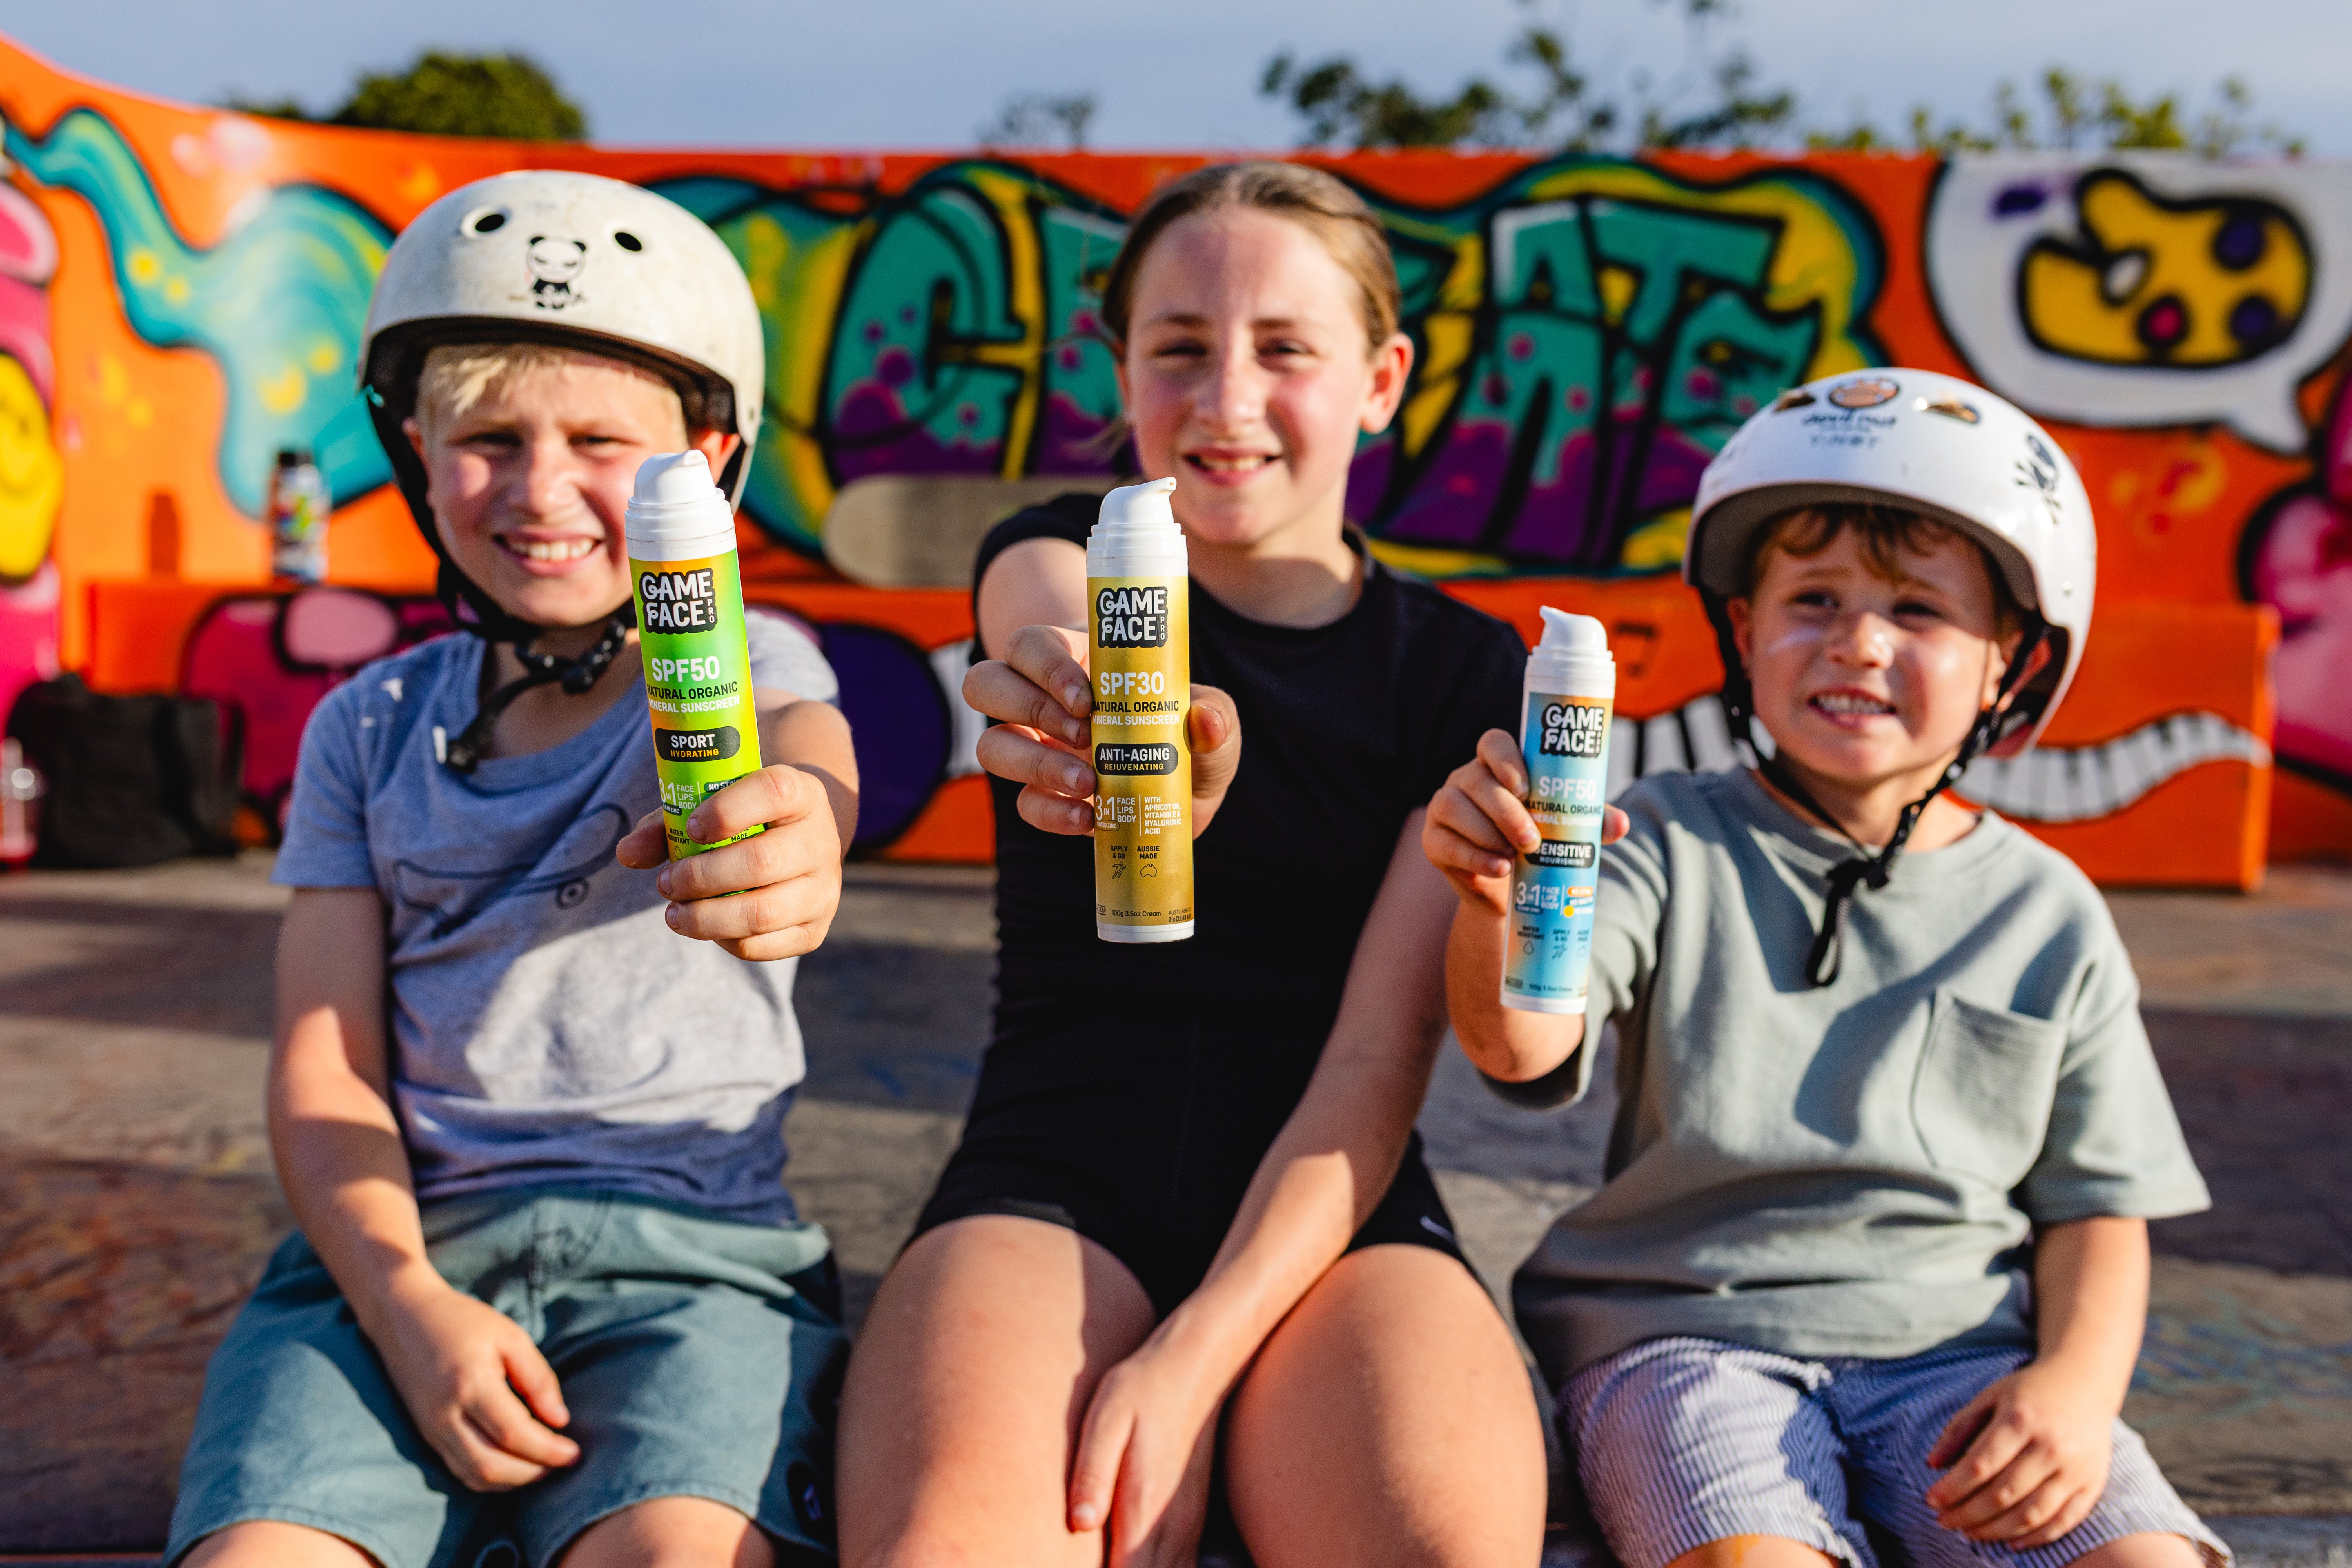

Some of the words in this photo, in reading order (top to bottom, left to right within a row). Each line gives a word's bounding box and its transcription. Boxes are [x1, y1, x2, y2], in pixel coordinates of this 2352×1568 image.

[642, 572, 713, 601] GAME
[1100, 590, 1165, 615] GAME
[647, 600, 706, 627] FACE
[1101, 616, 1157, 641] FACE
[651, 655, 720, 682] SPF50
[647, 684, 686, 700] NATURAL
[688, 681, 738, 699] ORGANIC
[1100, 671, 1165, 695] SPF30
[648, 698, 680, 713] MINERAL
[681, 695, 740, 713] SUNSCREEN
[1093, 701, 1132, 713] NATURAL
[1134, 700, 1179, 713] ORGANIC
[1093, 715, 1123, 725] MINERAL
[1125, 714, 1180, 726] SUNSCREEN
[1546, 706, 1604, 731] GAME
[671, 733, 715, 748] SPORT
[1544, 728, 1596, 754] FACE
[670, 748, 719, 757] HYDRATING
[1100, 747, 1170, 762] ANTI-AGING
[659, 777, 666, 803] 3
[668, 782, 676, 806] 1
[1538, 775, 1597, 800] SPF50
[678, 802, 697, 810] BODY
[1096, 795, 1103, 821] 3
[1106, 796, 1115, 821] 1
[1117, 797, 1136, 806] FACE
[1117, 806, 1134, 814] LIPS
[1117, 815, 1136, 823] BODY
[1145, 818, 1182, 827] HYALURONIC
[668, 833, 690, 845] RESISTANT
[669, 828, 684, 837] WATER
[731, 833, 748, 842] MADE
